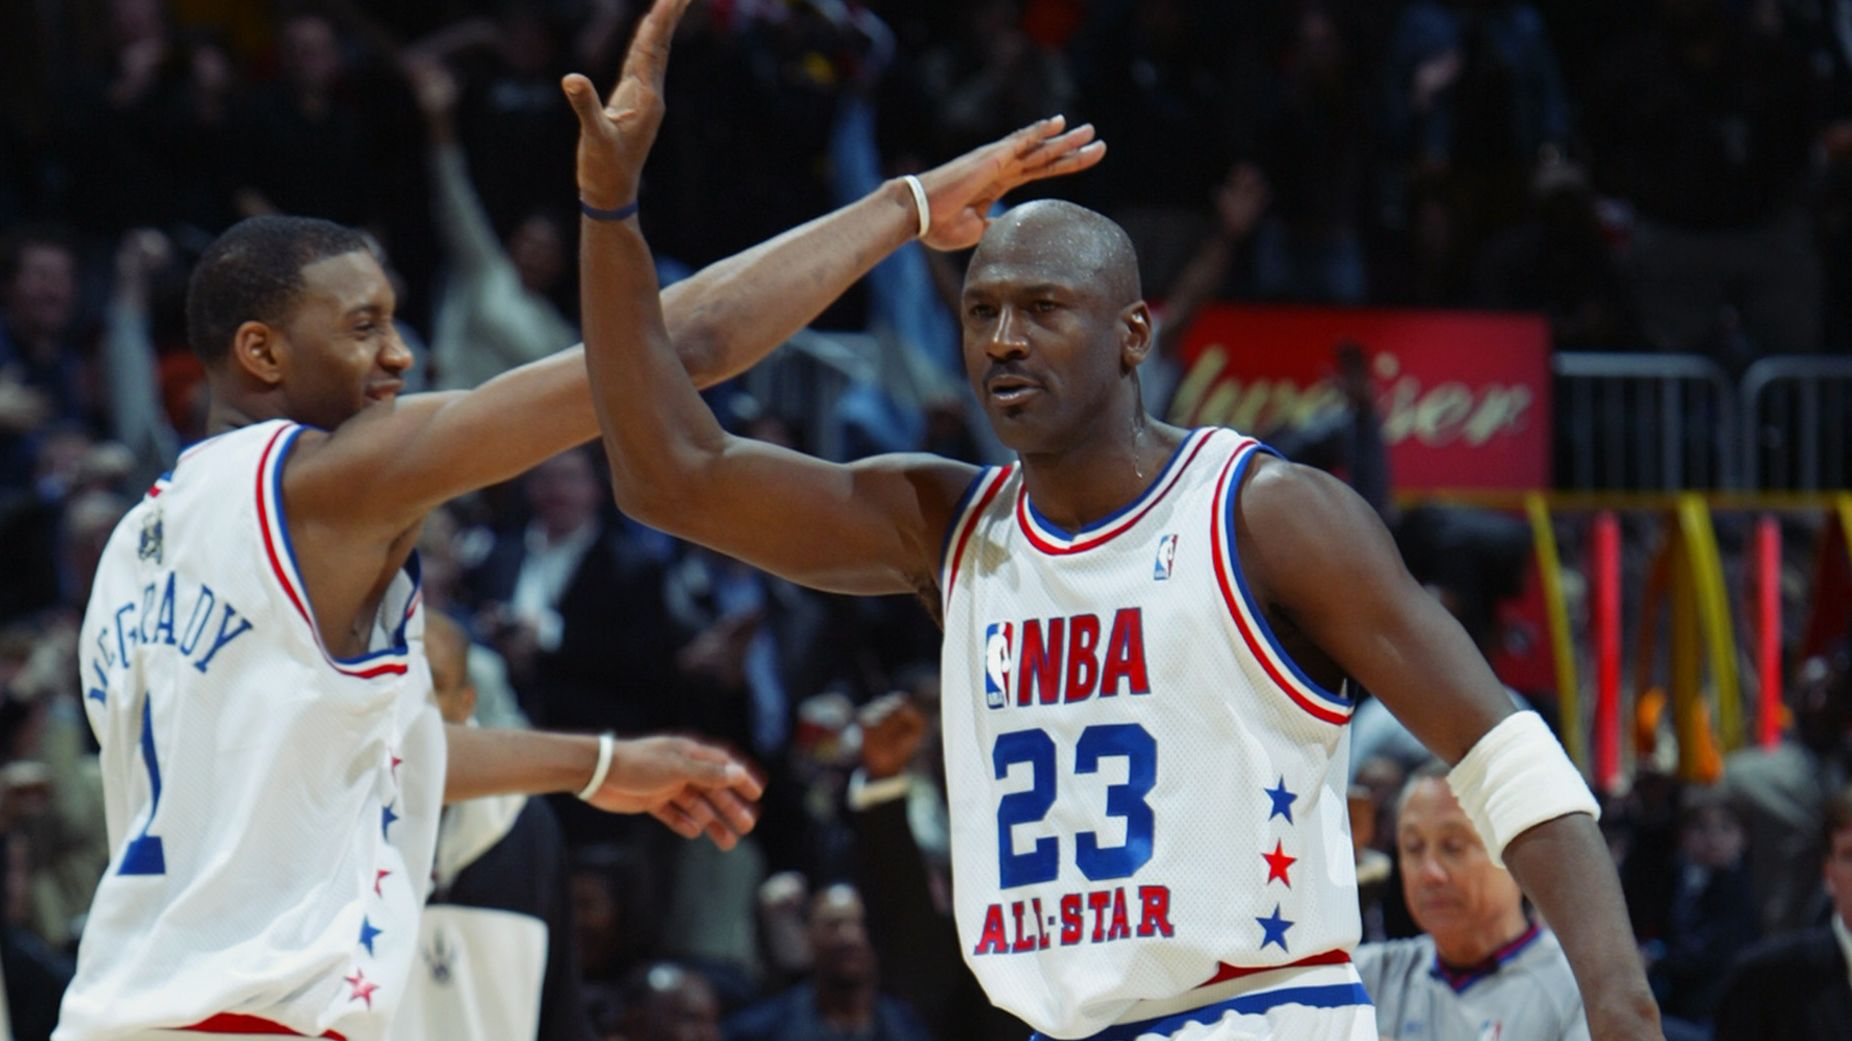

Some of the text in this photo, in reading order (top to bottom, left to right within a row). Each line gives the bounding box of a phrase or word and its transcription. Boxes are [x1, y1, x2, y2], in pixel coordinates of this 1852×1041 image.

[1017, 606, 1151, 707] NBA
[116, 690, 167, 876] 1
[992, 723, 1157, 890] 23
[973, 885, 1175, 956] ALL-STAR
